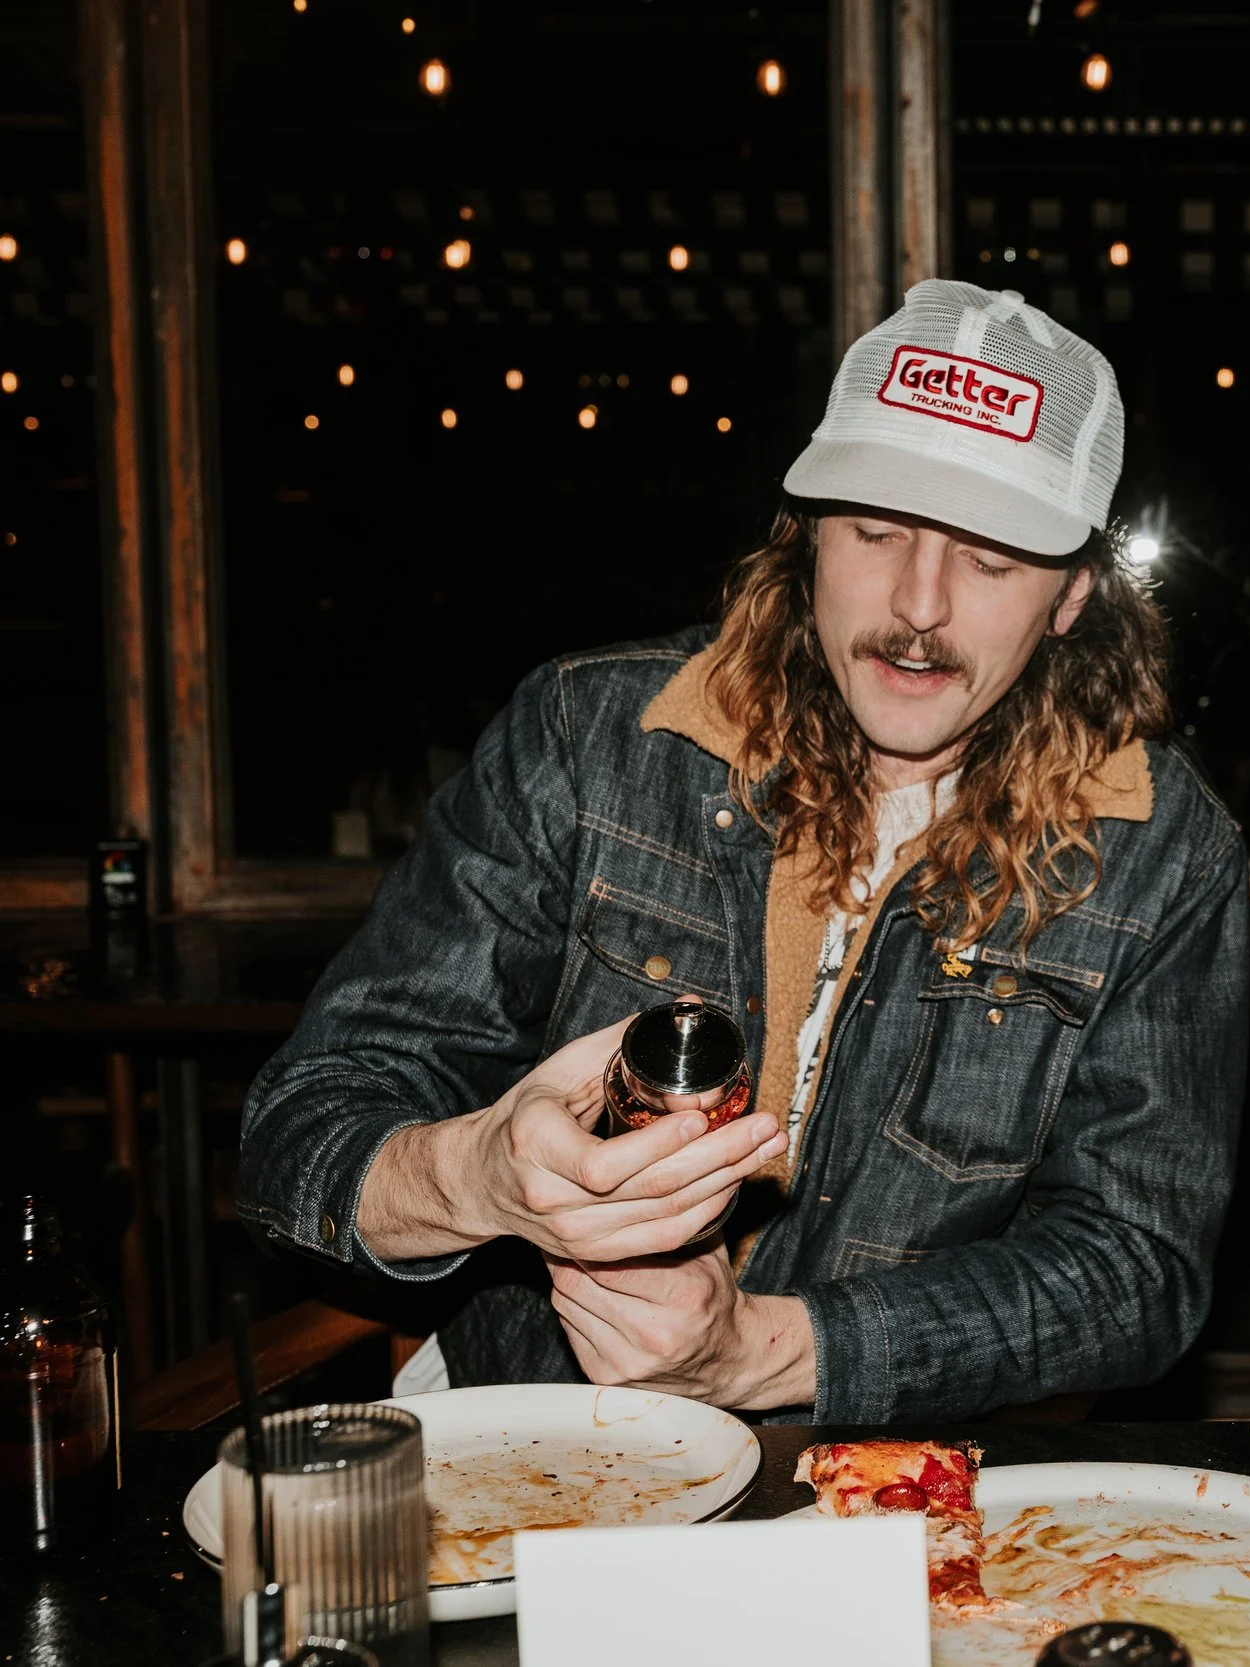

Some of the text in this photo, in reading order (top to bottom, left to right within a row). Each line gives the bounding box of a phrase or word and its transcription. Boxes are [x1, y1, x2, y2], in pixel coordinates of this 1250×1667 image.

[900, 358, 1031, 416] Getter
[911, 392, 1001, 426] TRUCKING INC.
